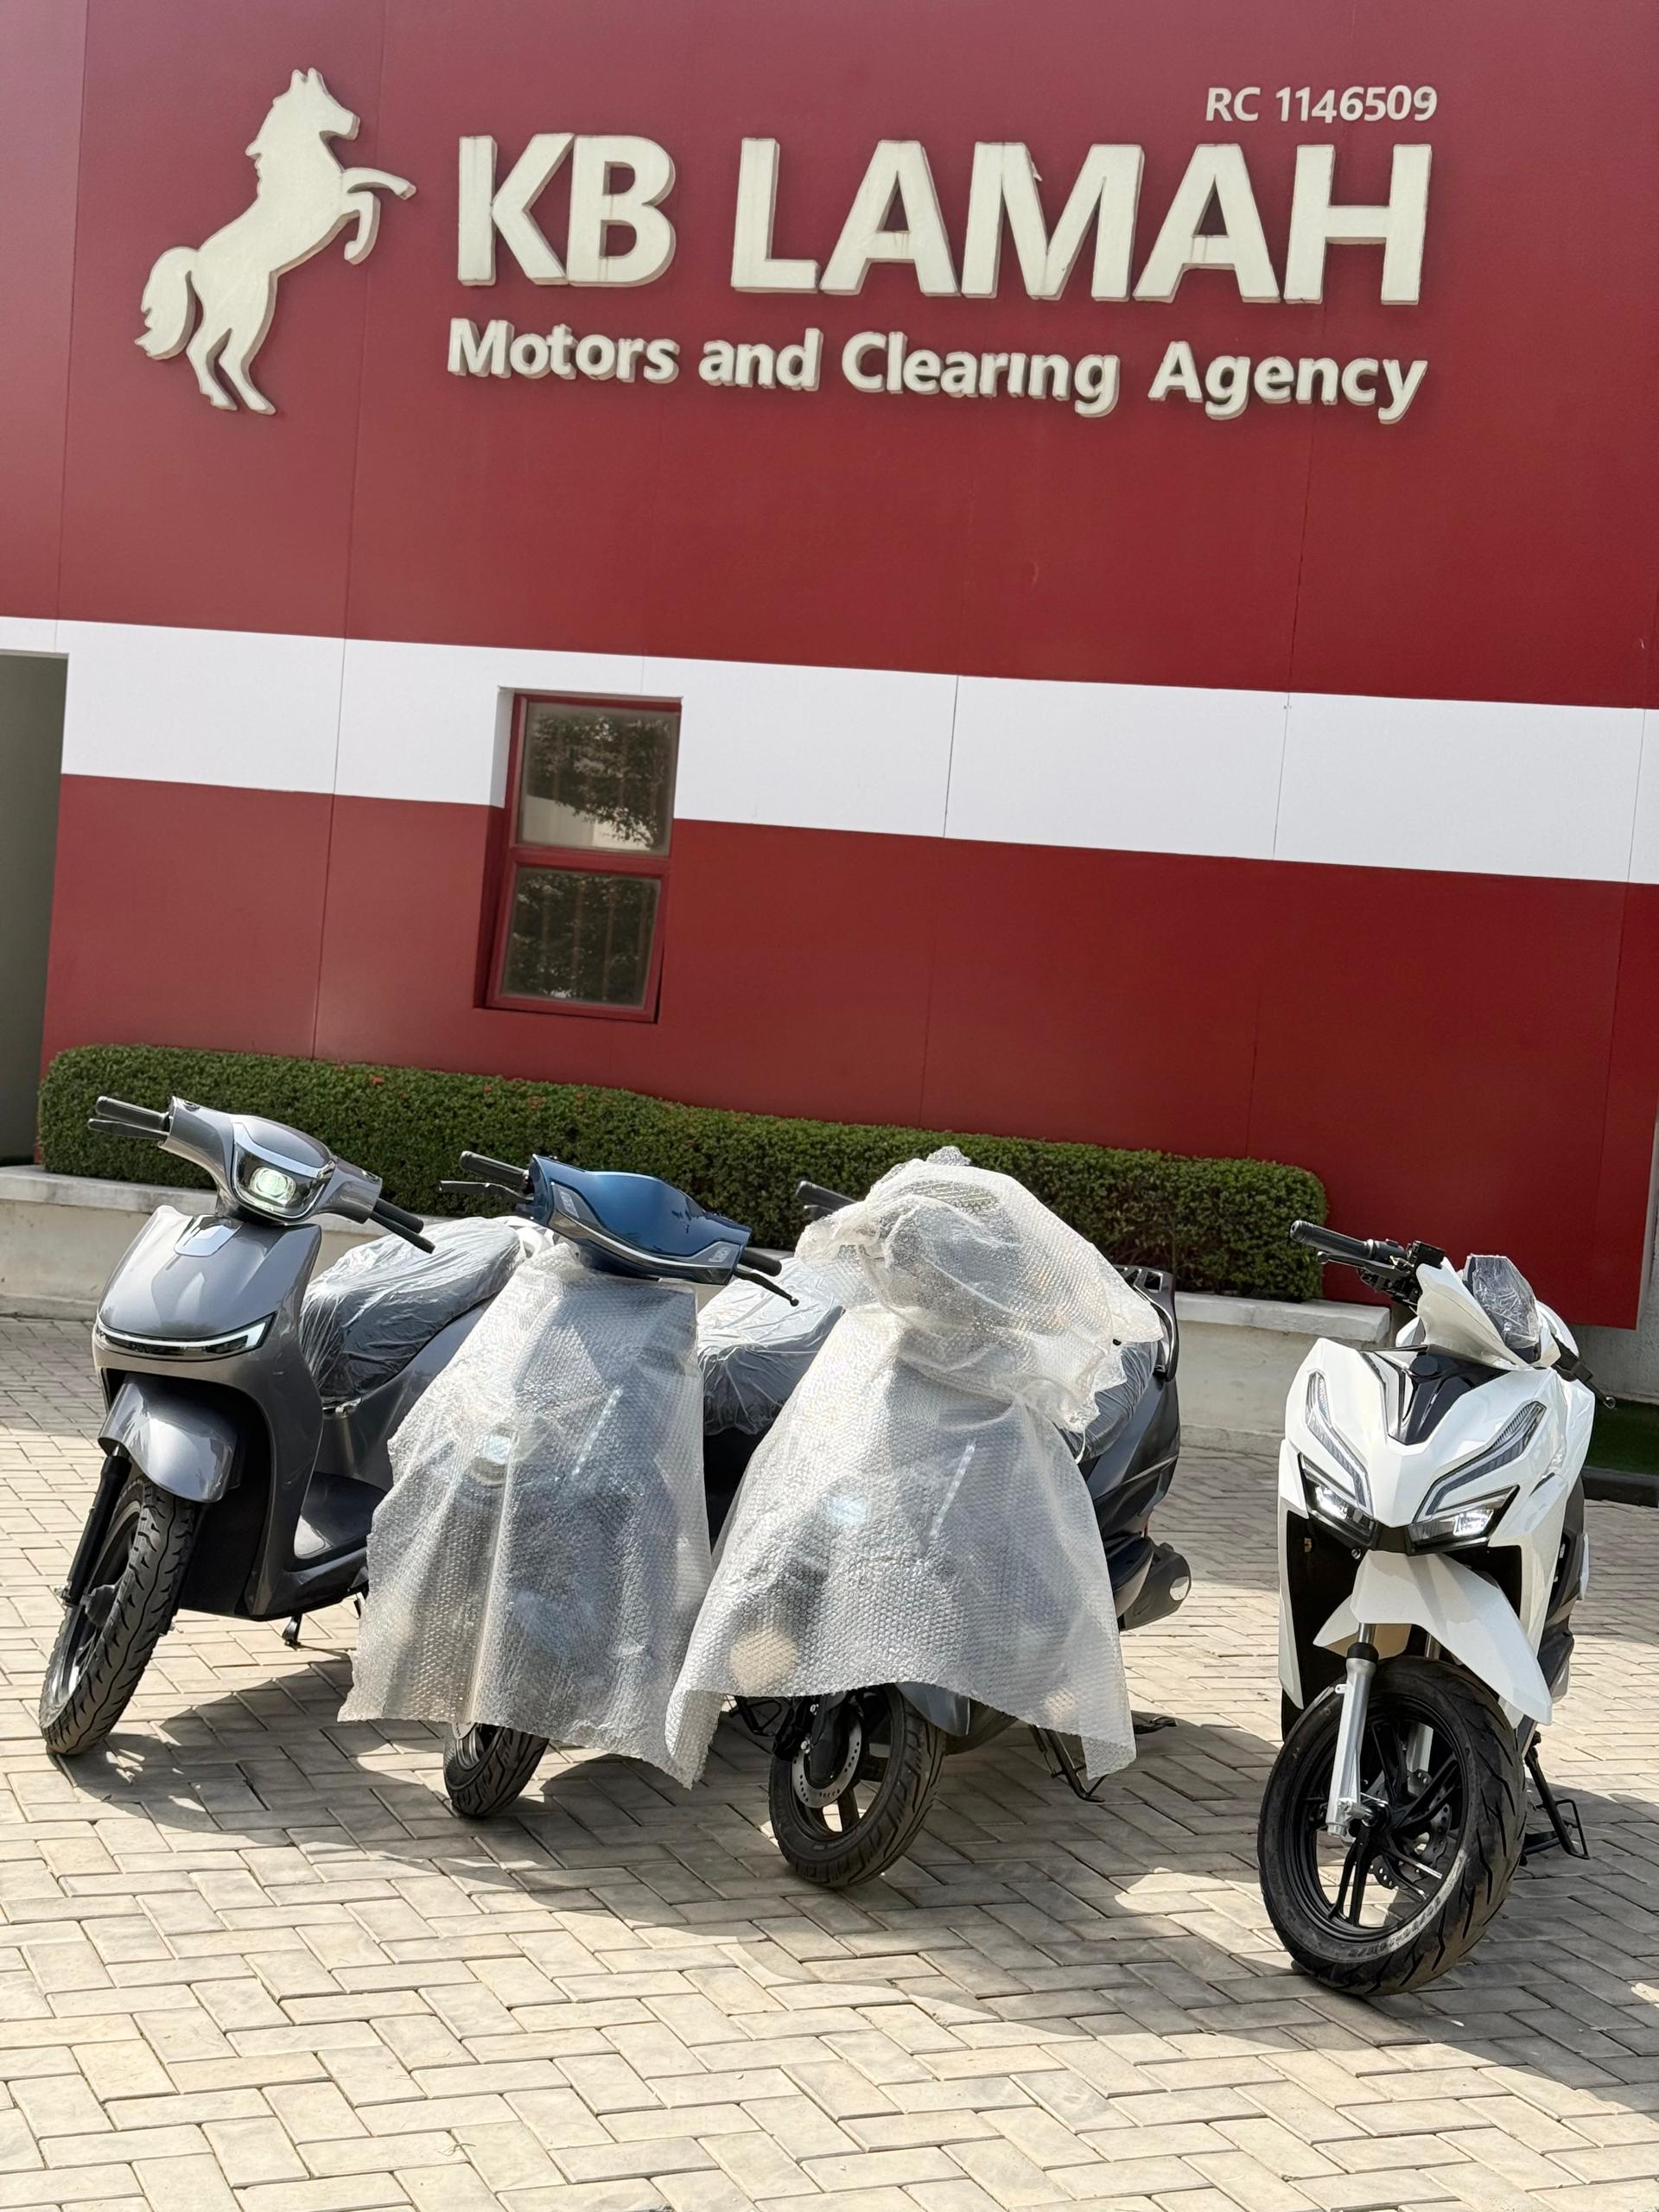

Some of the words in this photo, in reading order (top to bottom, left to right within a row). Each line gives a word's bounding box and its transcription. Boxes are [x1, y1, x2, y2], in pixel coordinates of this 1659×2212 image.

[1205, 86, 1261, 122] RC
[1275, 85, 1438, 124] 1146509
[457, 132, 677, 287] KB
[730, 138, 1433, 305] LAMAH
[448, 318, 680, 384] Motors
[698, 327, 823, 391] and
[842, 331, 1120, 418] Clearing
[1147, 340, 1428, 424] Agency
